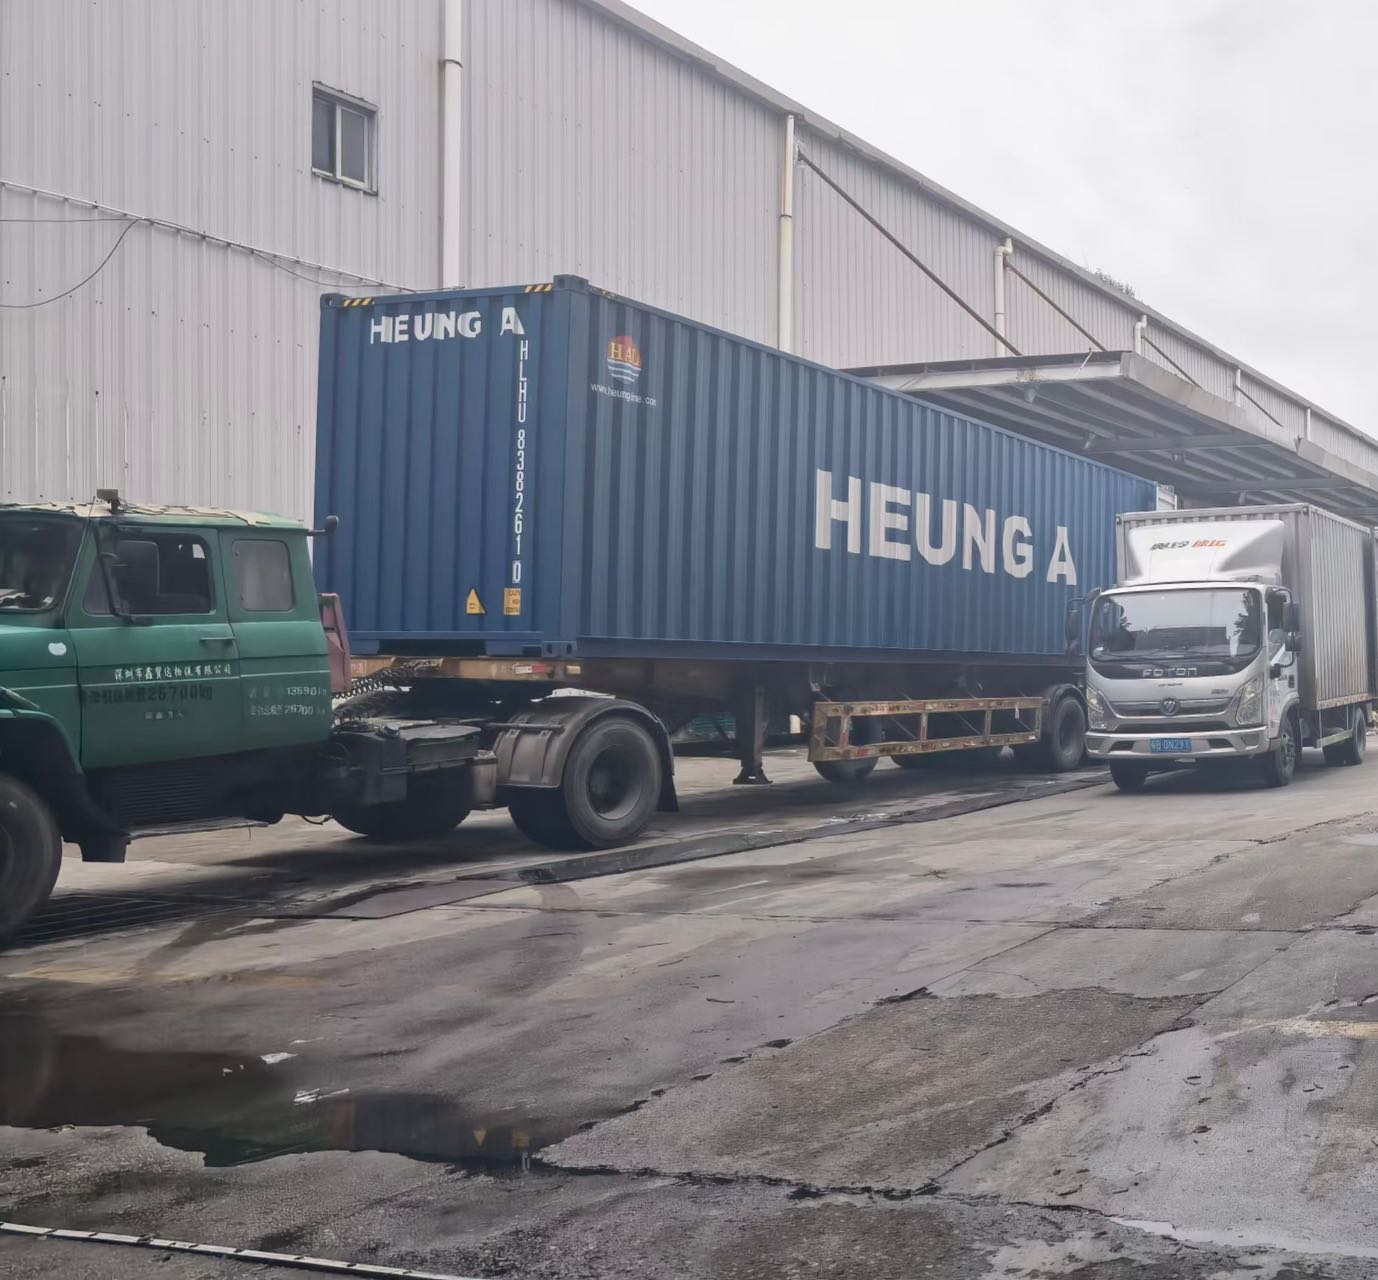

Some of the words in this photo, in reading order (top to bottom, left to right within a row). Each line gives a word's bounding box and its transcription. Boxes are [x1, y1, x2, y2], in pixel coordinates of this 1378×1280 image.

[370, 311, 481, 345] HEUNG
[500, 307, 525, 337] A
[518, 340, 528, 423] HLHU
[514, 429, 525, 555] 838261
[815, 468, 1033, 579] HEUNG
[1046, 526, 1077, 586] A
[1143, 667, 1198, 677] FOTON
